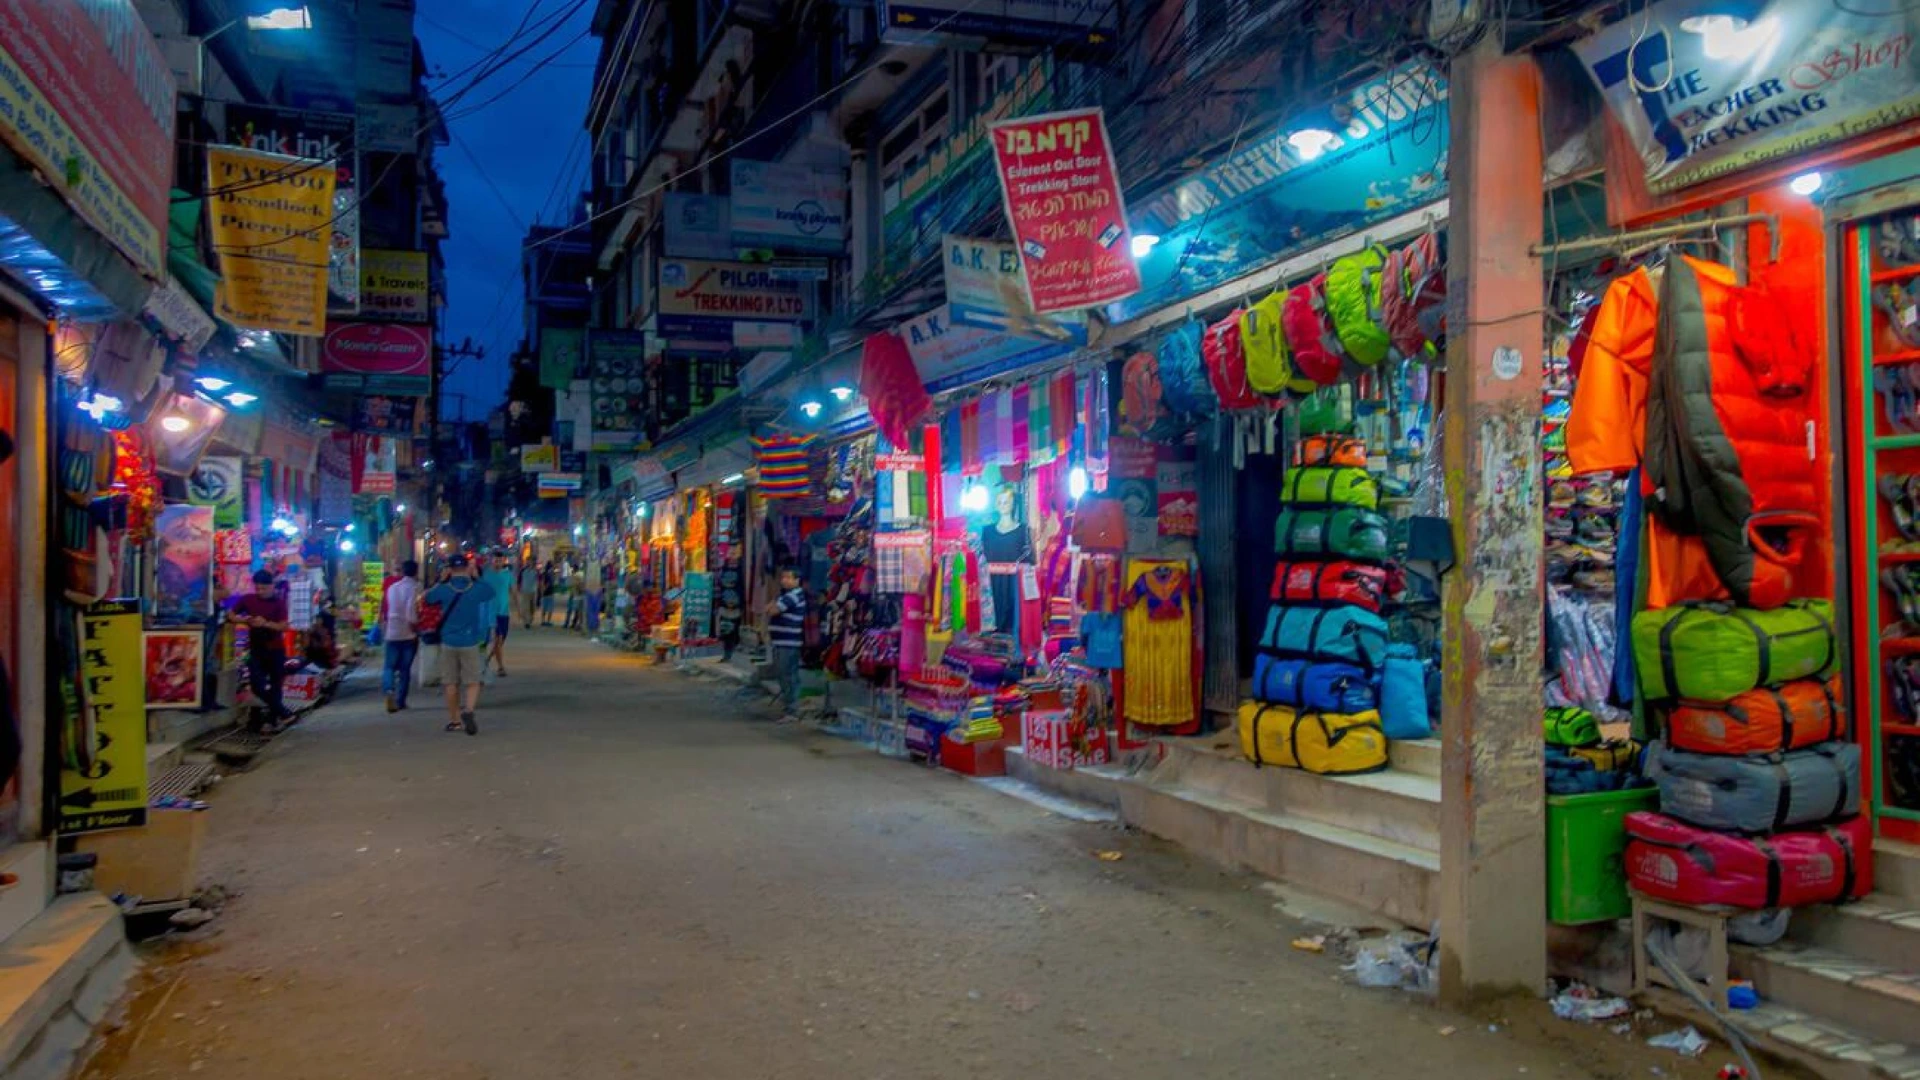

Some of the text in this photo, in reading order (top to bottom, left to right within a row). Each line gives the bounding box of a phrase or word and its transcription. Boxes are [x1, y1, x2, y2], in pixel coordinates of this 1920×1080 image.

[1789, 34, 1914, 90] Shop
[297, 131, 338, 158] ink
[220, 161, 326, 191] TATTOO
[1007, 154, 1103, 180] Everest Out Door
[1018, 172, 1101, 195] Trekking Store
[220, 214, 321, 242] Piercing
[776, 208, 842, 225] lonely planet
[951, 245, 990, 271] A.K.
[380, 275, 426, 292] Travels
[361, 292, 417, 312] ique
[692, 293, 763, 312] TREKKING
[910, 315, 951, 345] A.K.
[335, 338, 419, 355] MoneyGram
